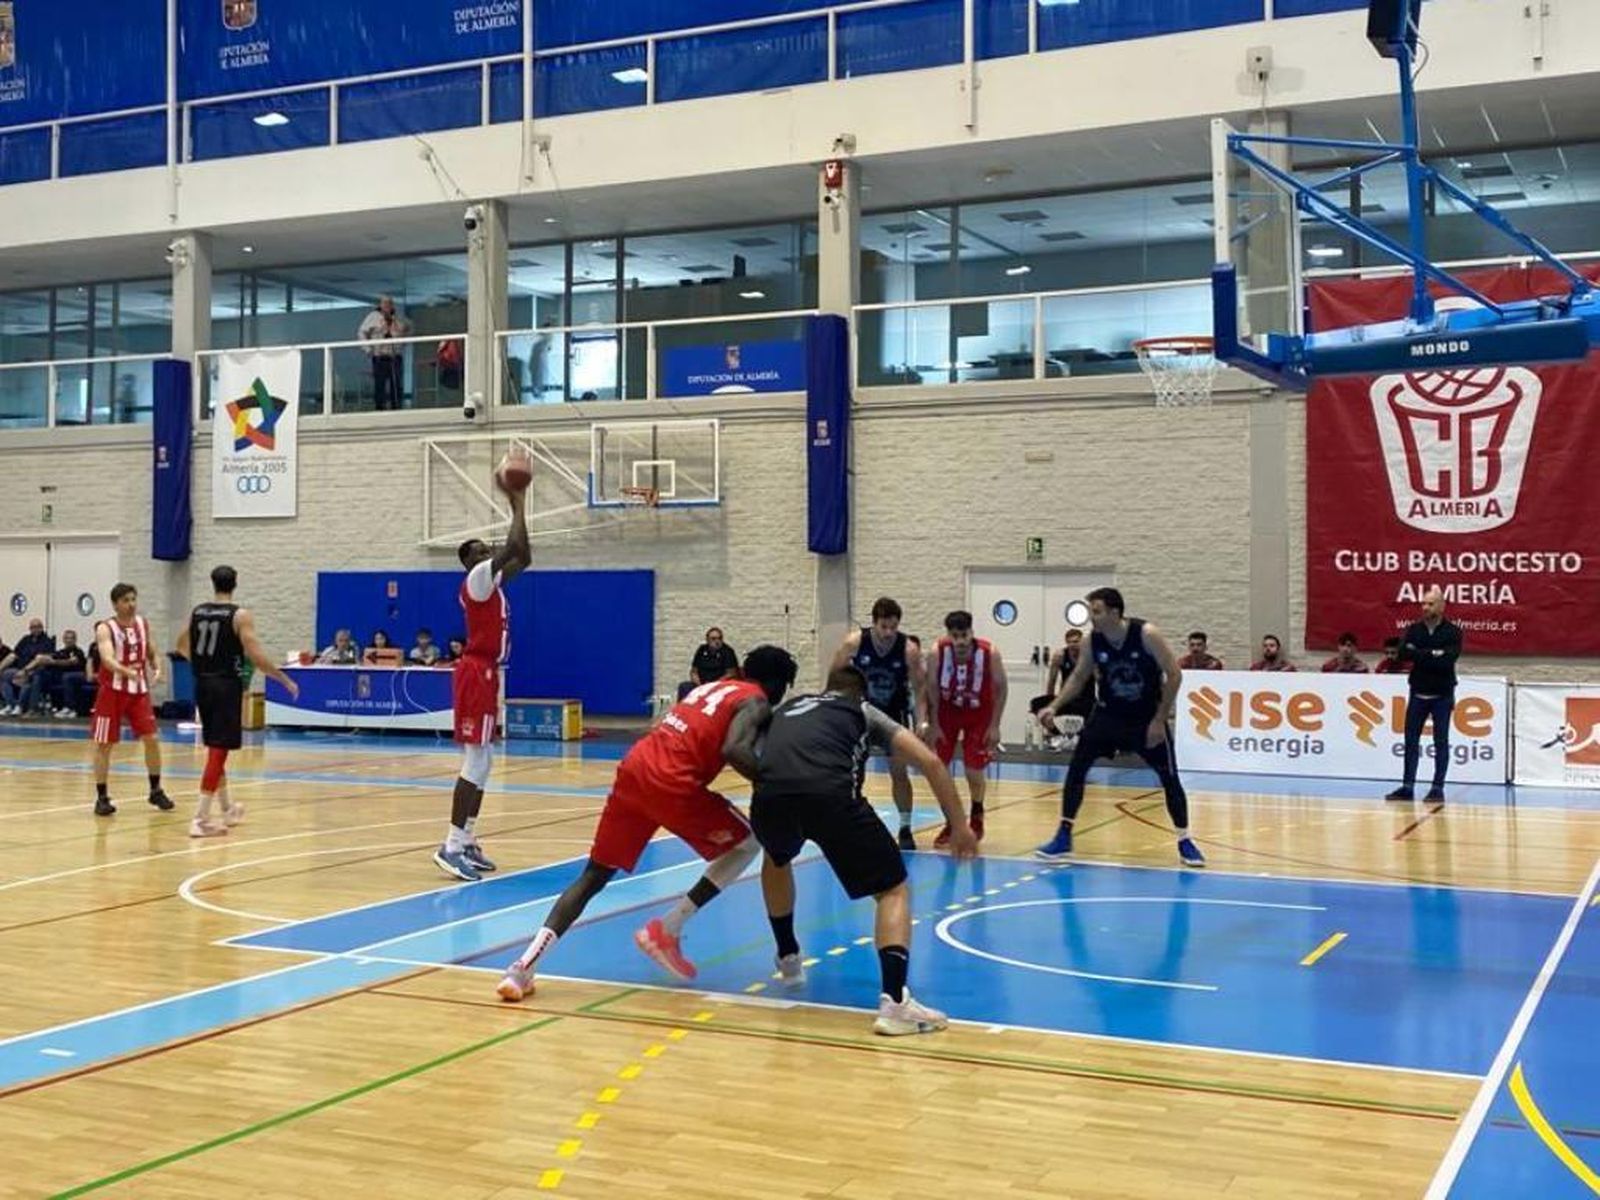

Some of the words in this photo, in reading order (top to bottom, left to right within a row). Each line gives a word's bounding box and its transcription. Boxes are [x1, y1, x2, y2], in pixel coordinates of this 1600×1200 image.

[454, 0, 519, 20] DIPUTACIÓN
[1410, 341, 1469, 356] MONDO
[262, 462, 288, 473] 2005
[1335, 549, 1399, 572] CLUB
[1408, 550, 1582, 573] BALONCESTO
[1396, 578, 1516, 605] ALMERÍA
[196, 620, 220, 656] 11
